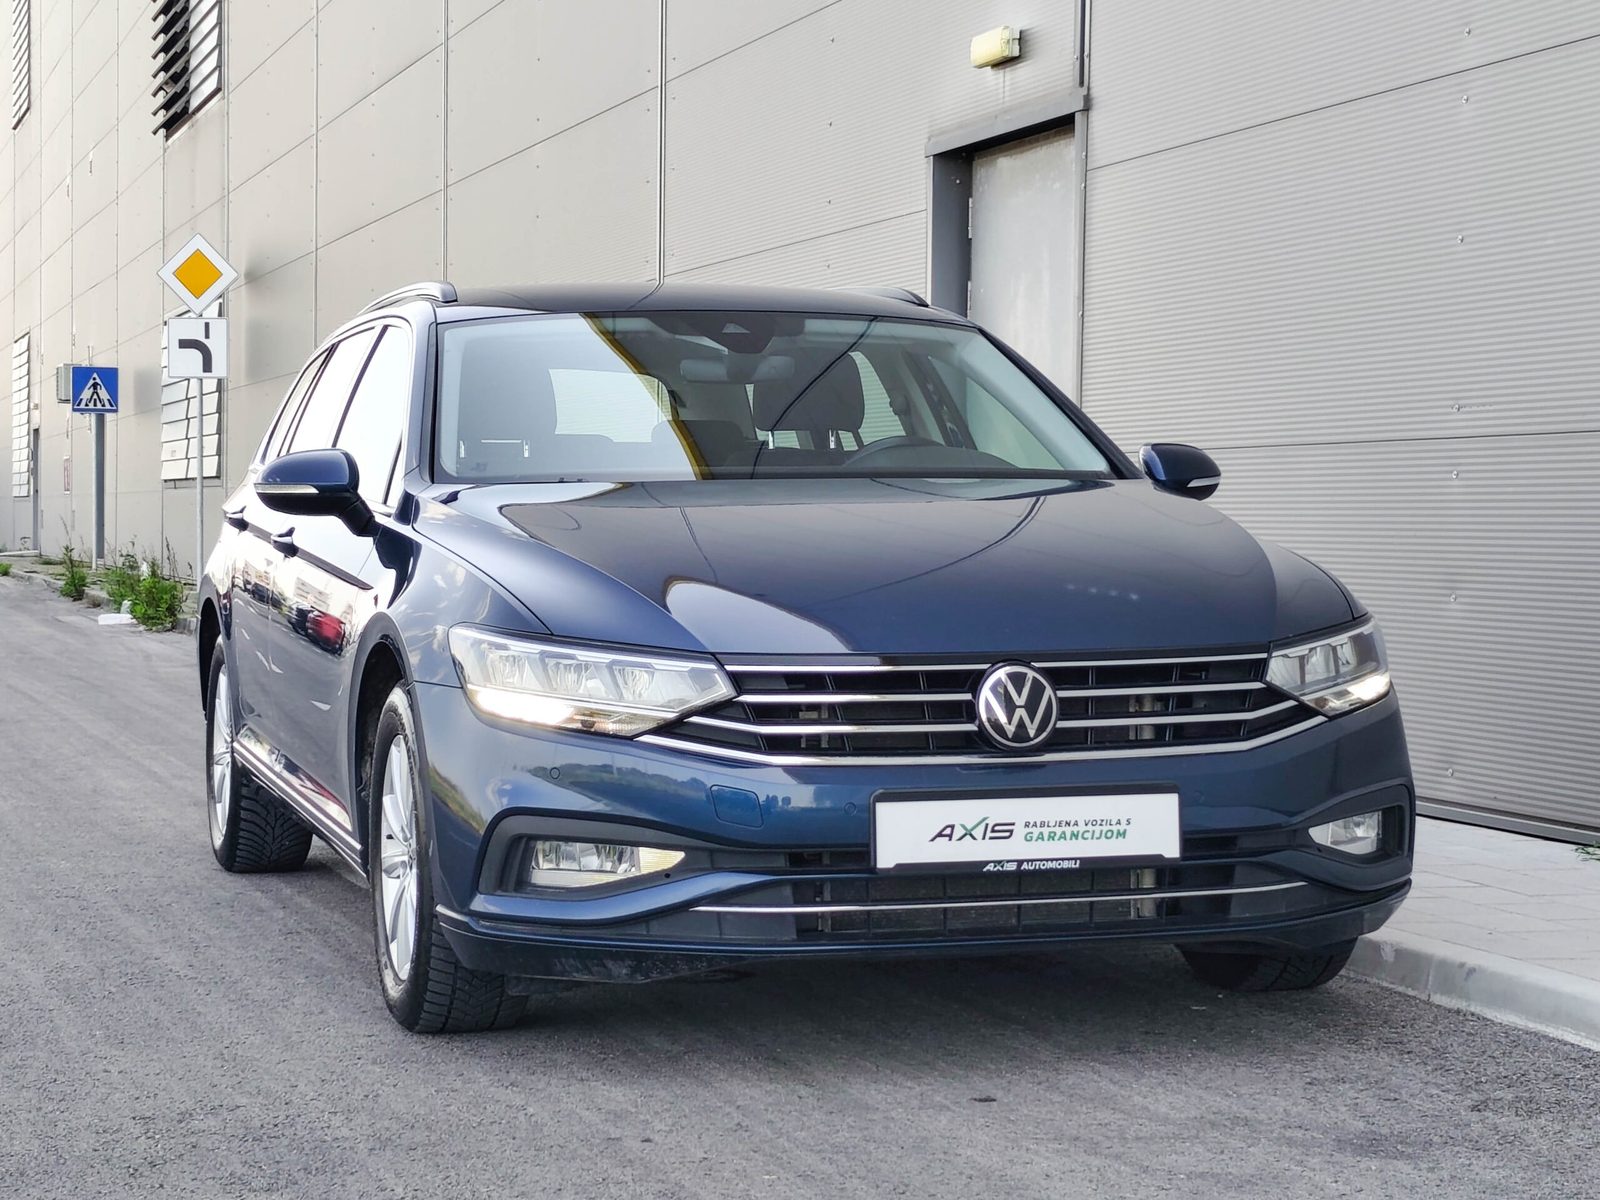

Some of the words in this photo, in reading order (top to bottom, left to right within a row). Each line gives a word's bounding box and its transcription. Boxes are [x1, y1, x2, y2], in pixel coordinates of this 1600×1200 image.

[928, 816, 1016, 842] AXIS
[1024, 820, 1079, 829] RABLJENA
[1084, 818, 1122, 827] VOZILA
[1024, 828, 1128, 842] GARANCIJOM
[982, 861, 1018, 872] AXIS
[1020, 859, 1080, 870] AUTOMOBILI
